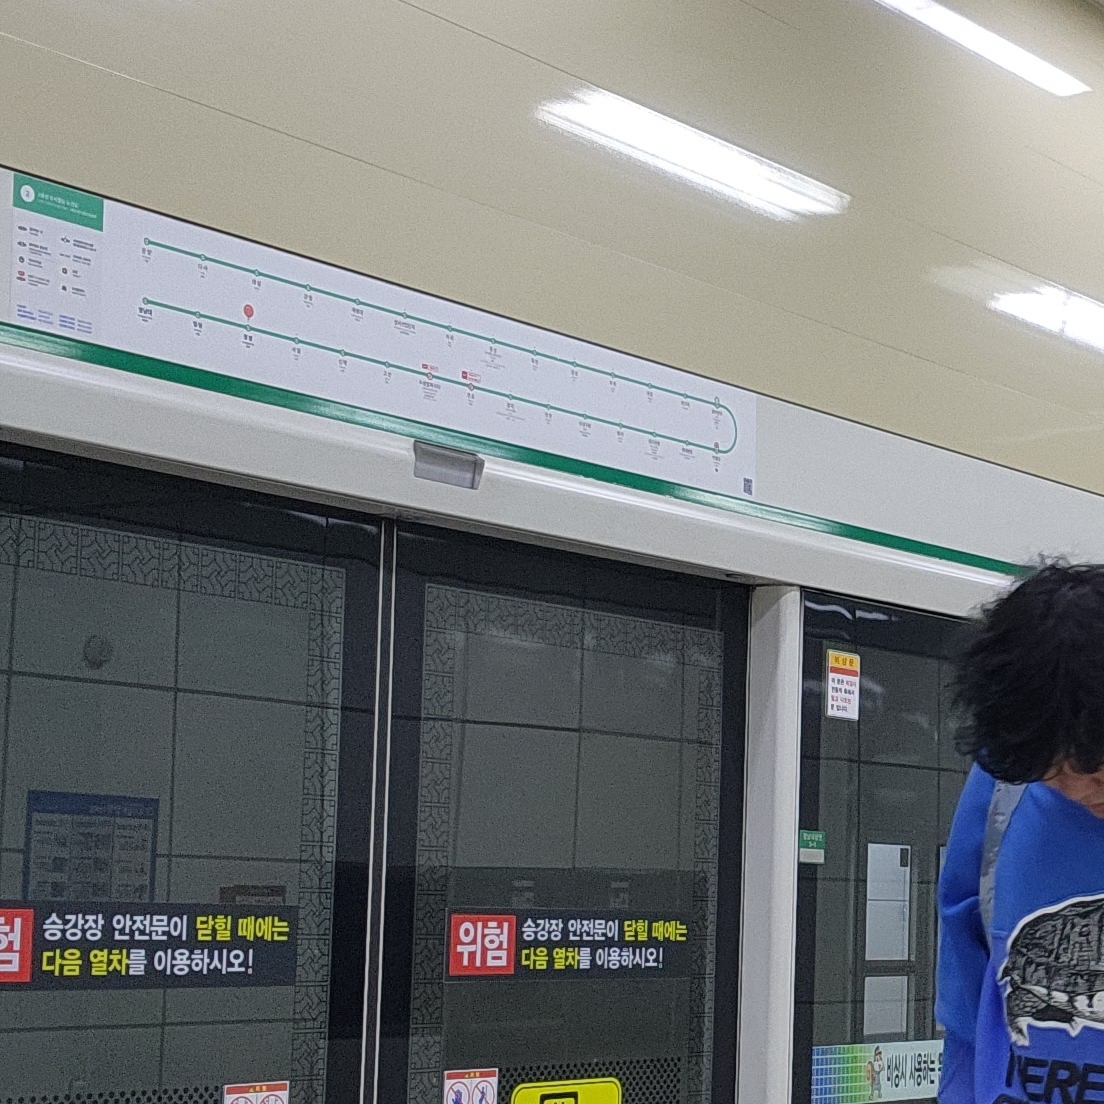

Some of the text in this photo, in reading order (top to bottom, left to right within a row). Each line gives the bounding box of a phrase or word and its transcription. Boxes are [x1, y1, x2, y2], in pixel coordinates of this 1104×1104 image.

[0, 913, 290, 973] 험 승강장 안전문이 닫힐 때에는
[456, 921, 509, 967] 위험
[521, 918, 687, 942] 승강장 안전문이 닫힐 때에는
[41, 949, 254, 976] 다음 열차를 이용하시오!
[521, 947, 663, 970] 다음 열차를 이용하시오!
[886, 1052, 936, 1088] 비상시 사용하는
